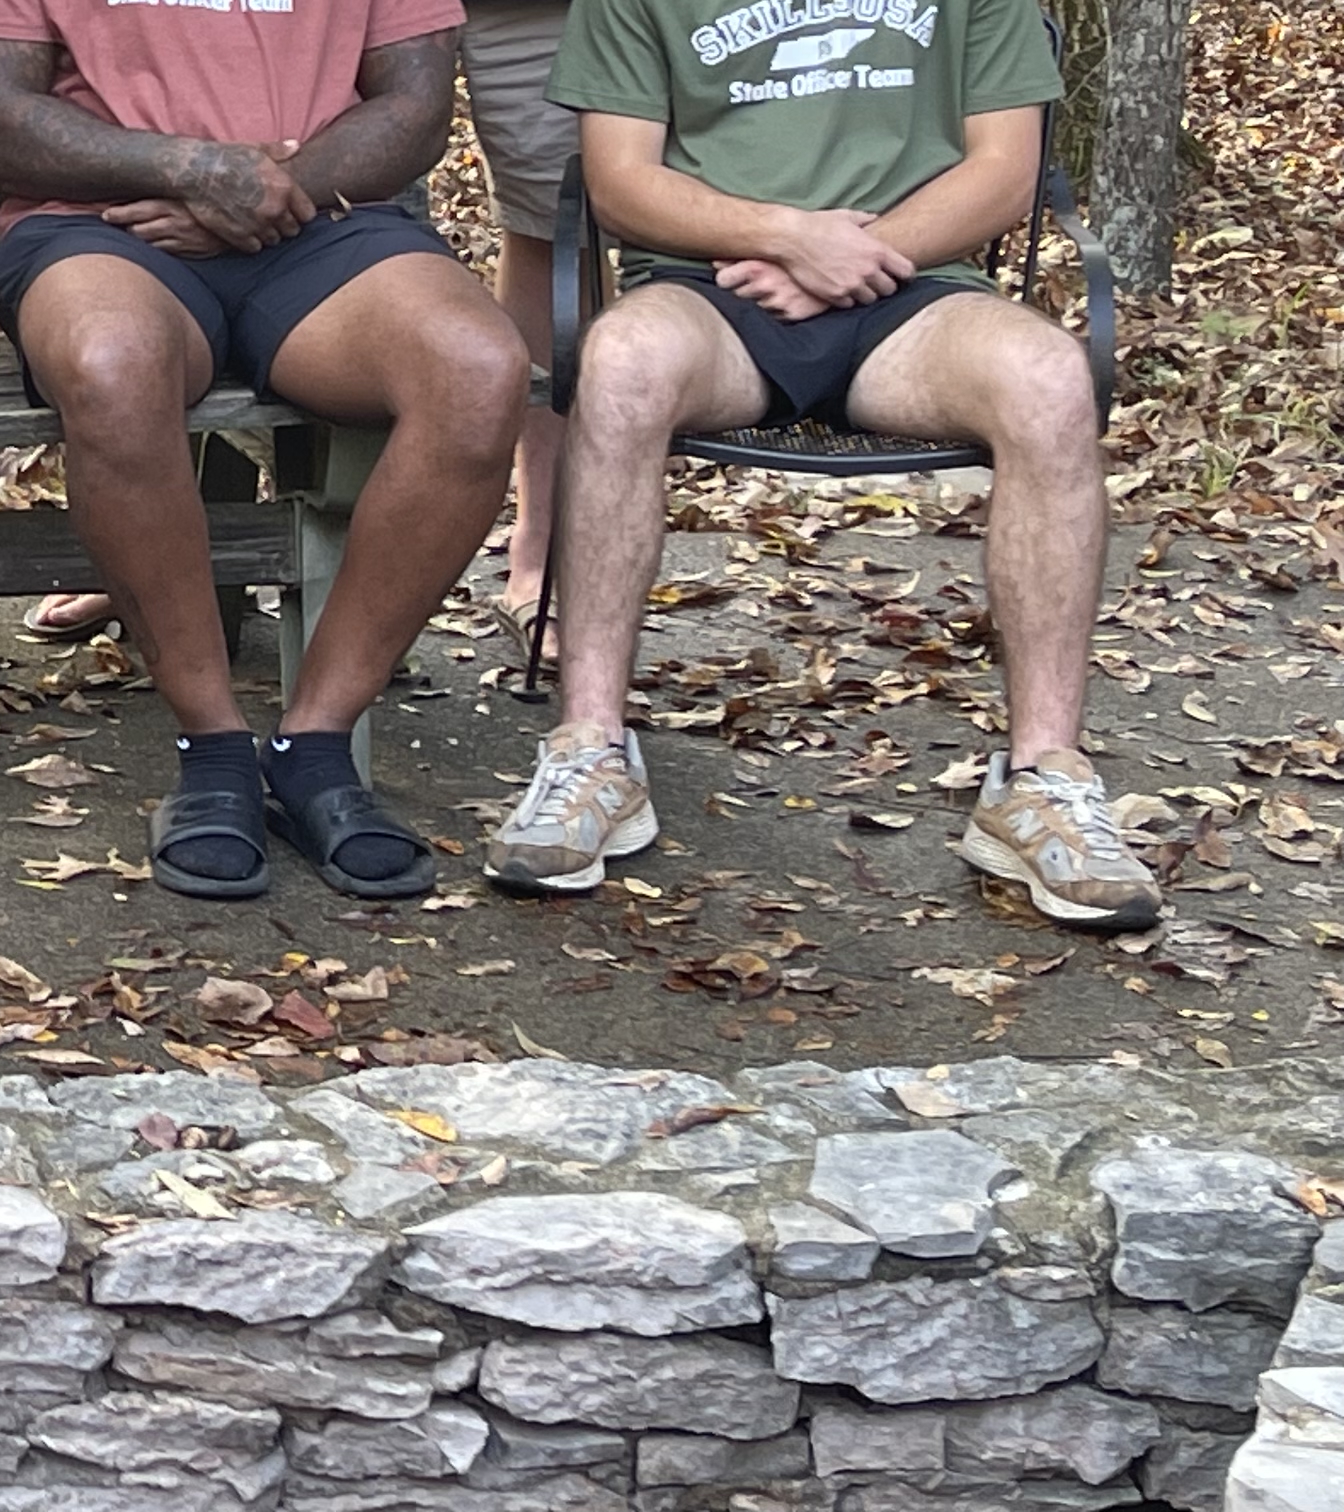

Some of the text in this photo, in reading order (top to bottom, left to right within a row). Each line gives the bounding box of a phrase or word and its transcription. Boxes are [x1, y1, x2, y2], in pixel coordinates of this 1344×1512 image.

[729, 65, 914, 104] State Officer Team
